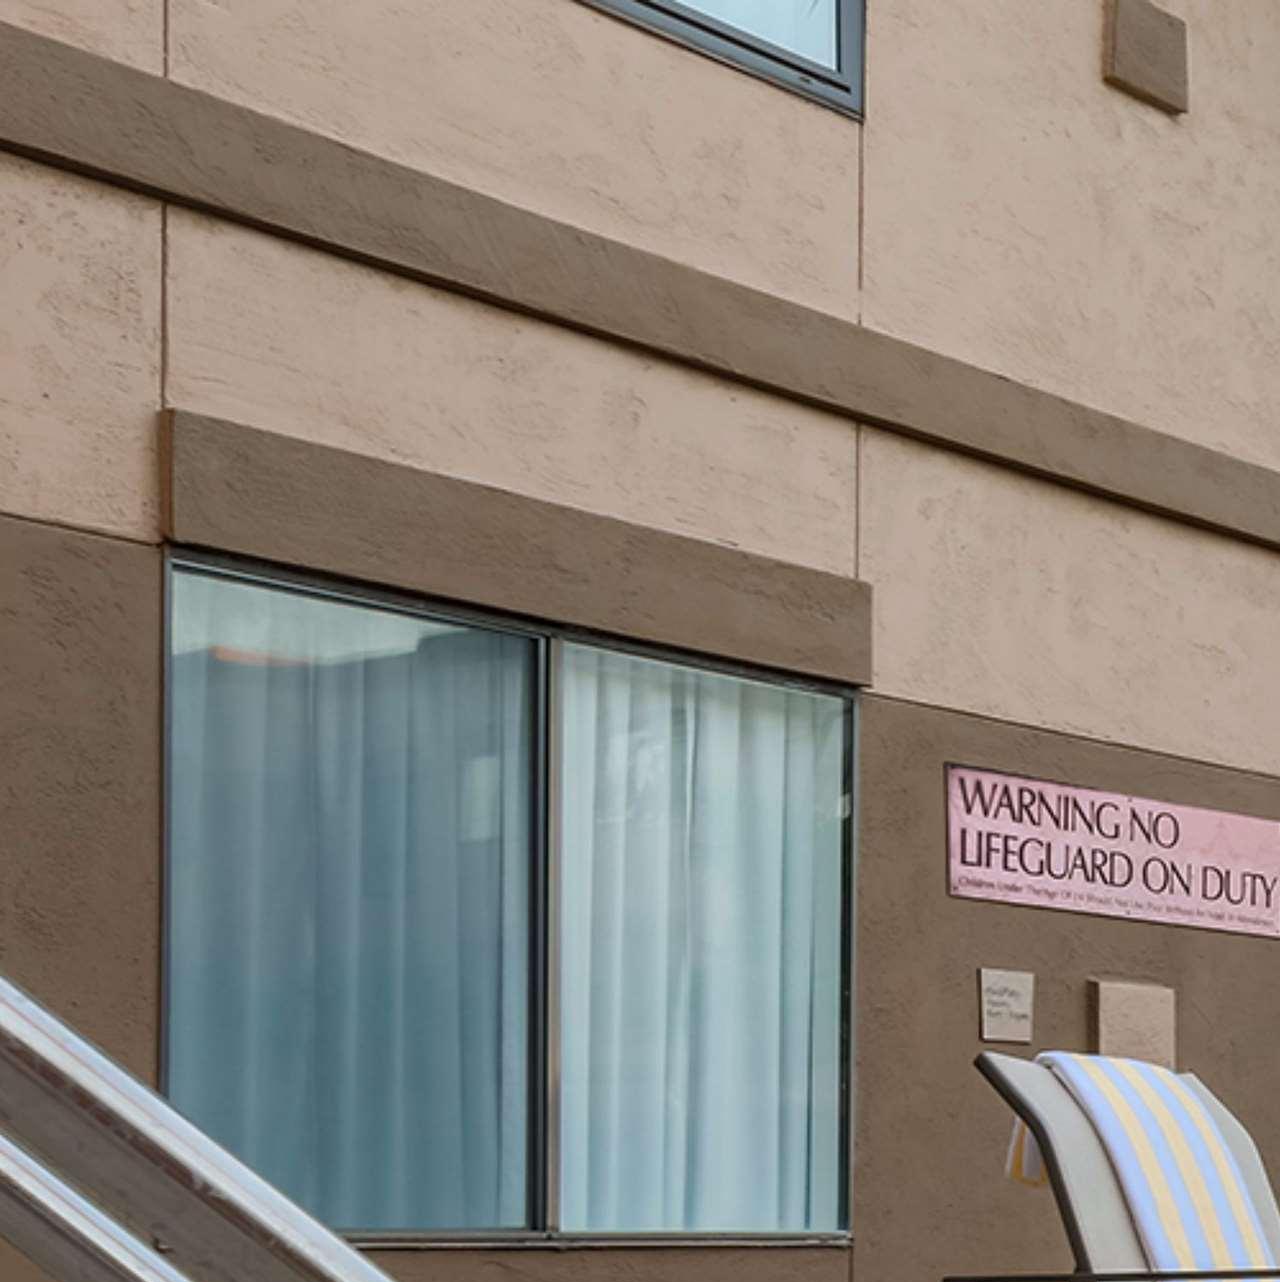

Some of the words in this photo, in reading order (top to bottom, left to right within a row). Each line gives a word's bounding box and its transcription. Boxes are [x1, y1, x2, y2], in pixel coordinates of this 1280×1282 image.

[958, 776, 1120, 840] WARNING
[1129, 806, 1180, 849] NO
[960, 828, 1134, 888] LIFEGUARD
[1142, 857, 1192, 896] ON
[1201, 865, 1278, 908] DUTY
